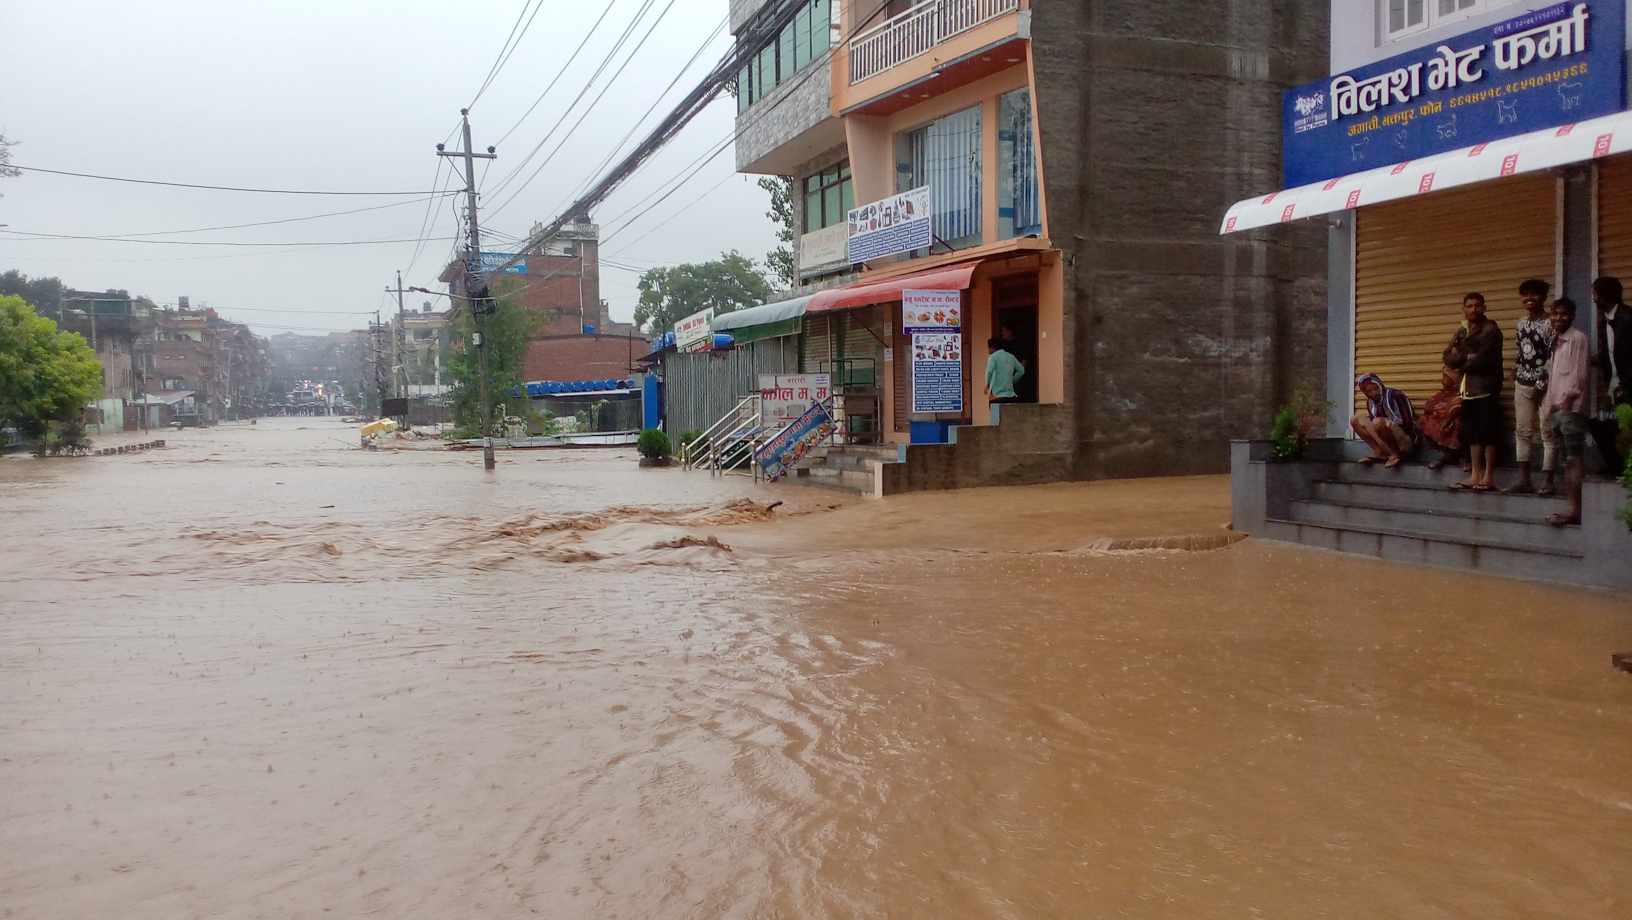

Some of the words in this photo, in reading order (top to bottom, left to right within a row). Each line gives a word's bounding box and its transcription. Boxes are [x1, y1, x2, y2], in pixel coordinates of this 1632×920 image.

[1427, 45, 1486, 92] भेट
[1492, 2, 1589, 70] फर्मा
[1419, 100, 1442, 117] फोन
